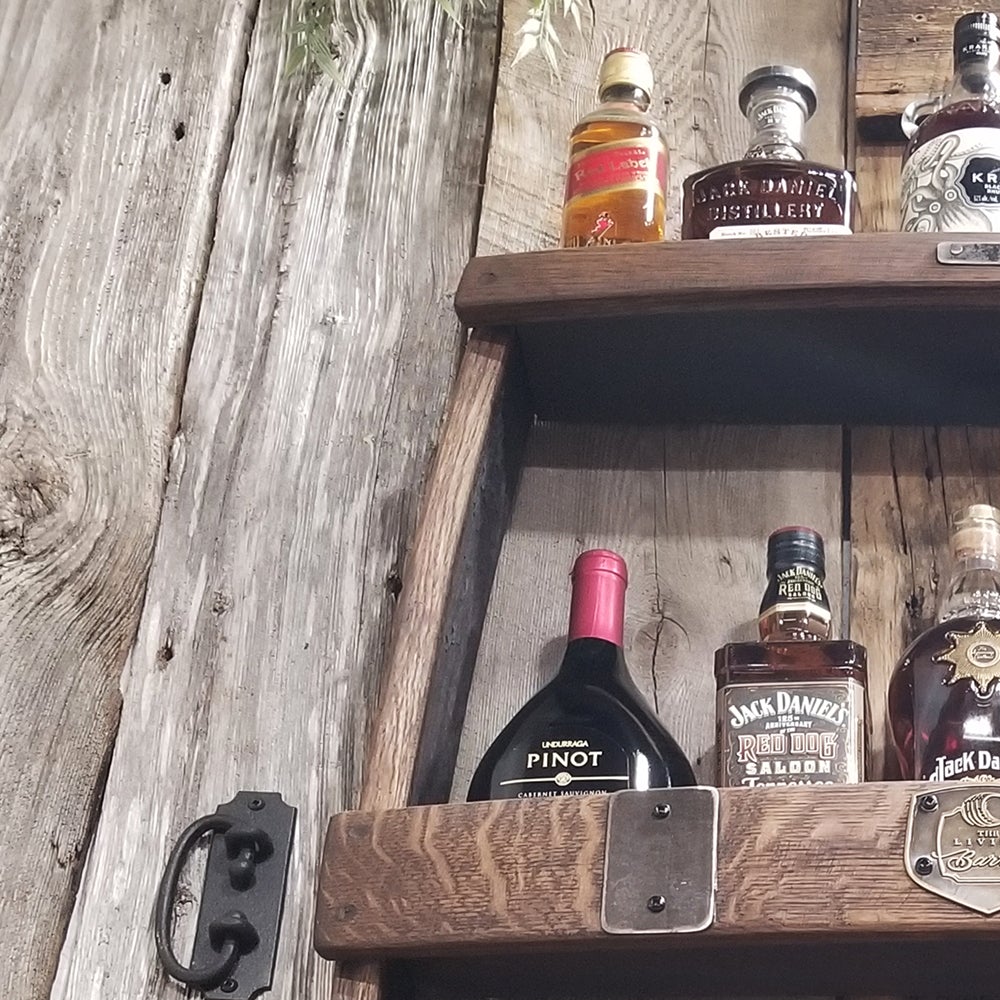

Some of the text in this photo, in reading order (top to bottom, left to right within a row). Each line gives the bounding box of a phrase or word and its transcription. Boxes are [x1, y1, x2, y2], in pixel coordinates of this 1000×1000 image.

[697, 179, 750, 203] JACK
[708, 203, 824, 220] DISTILLERY
[778, 582, 822, 601] RED DOG
[728, 691, 849, 728] JACK DANIEL'S
[542, 740, 589, 749] UNDURRAGA
[737, 732, 838, 762] RED DOG
[527, 750, 603, 768] PINOT
[745, 760, 831, 775] SALOON
[518, 790, 557, 798] CABERNET
